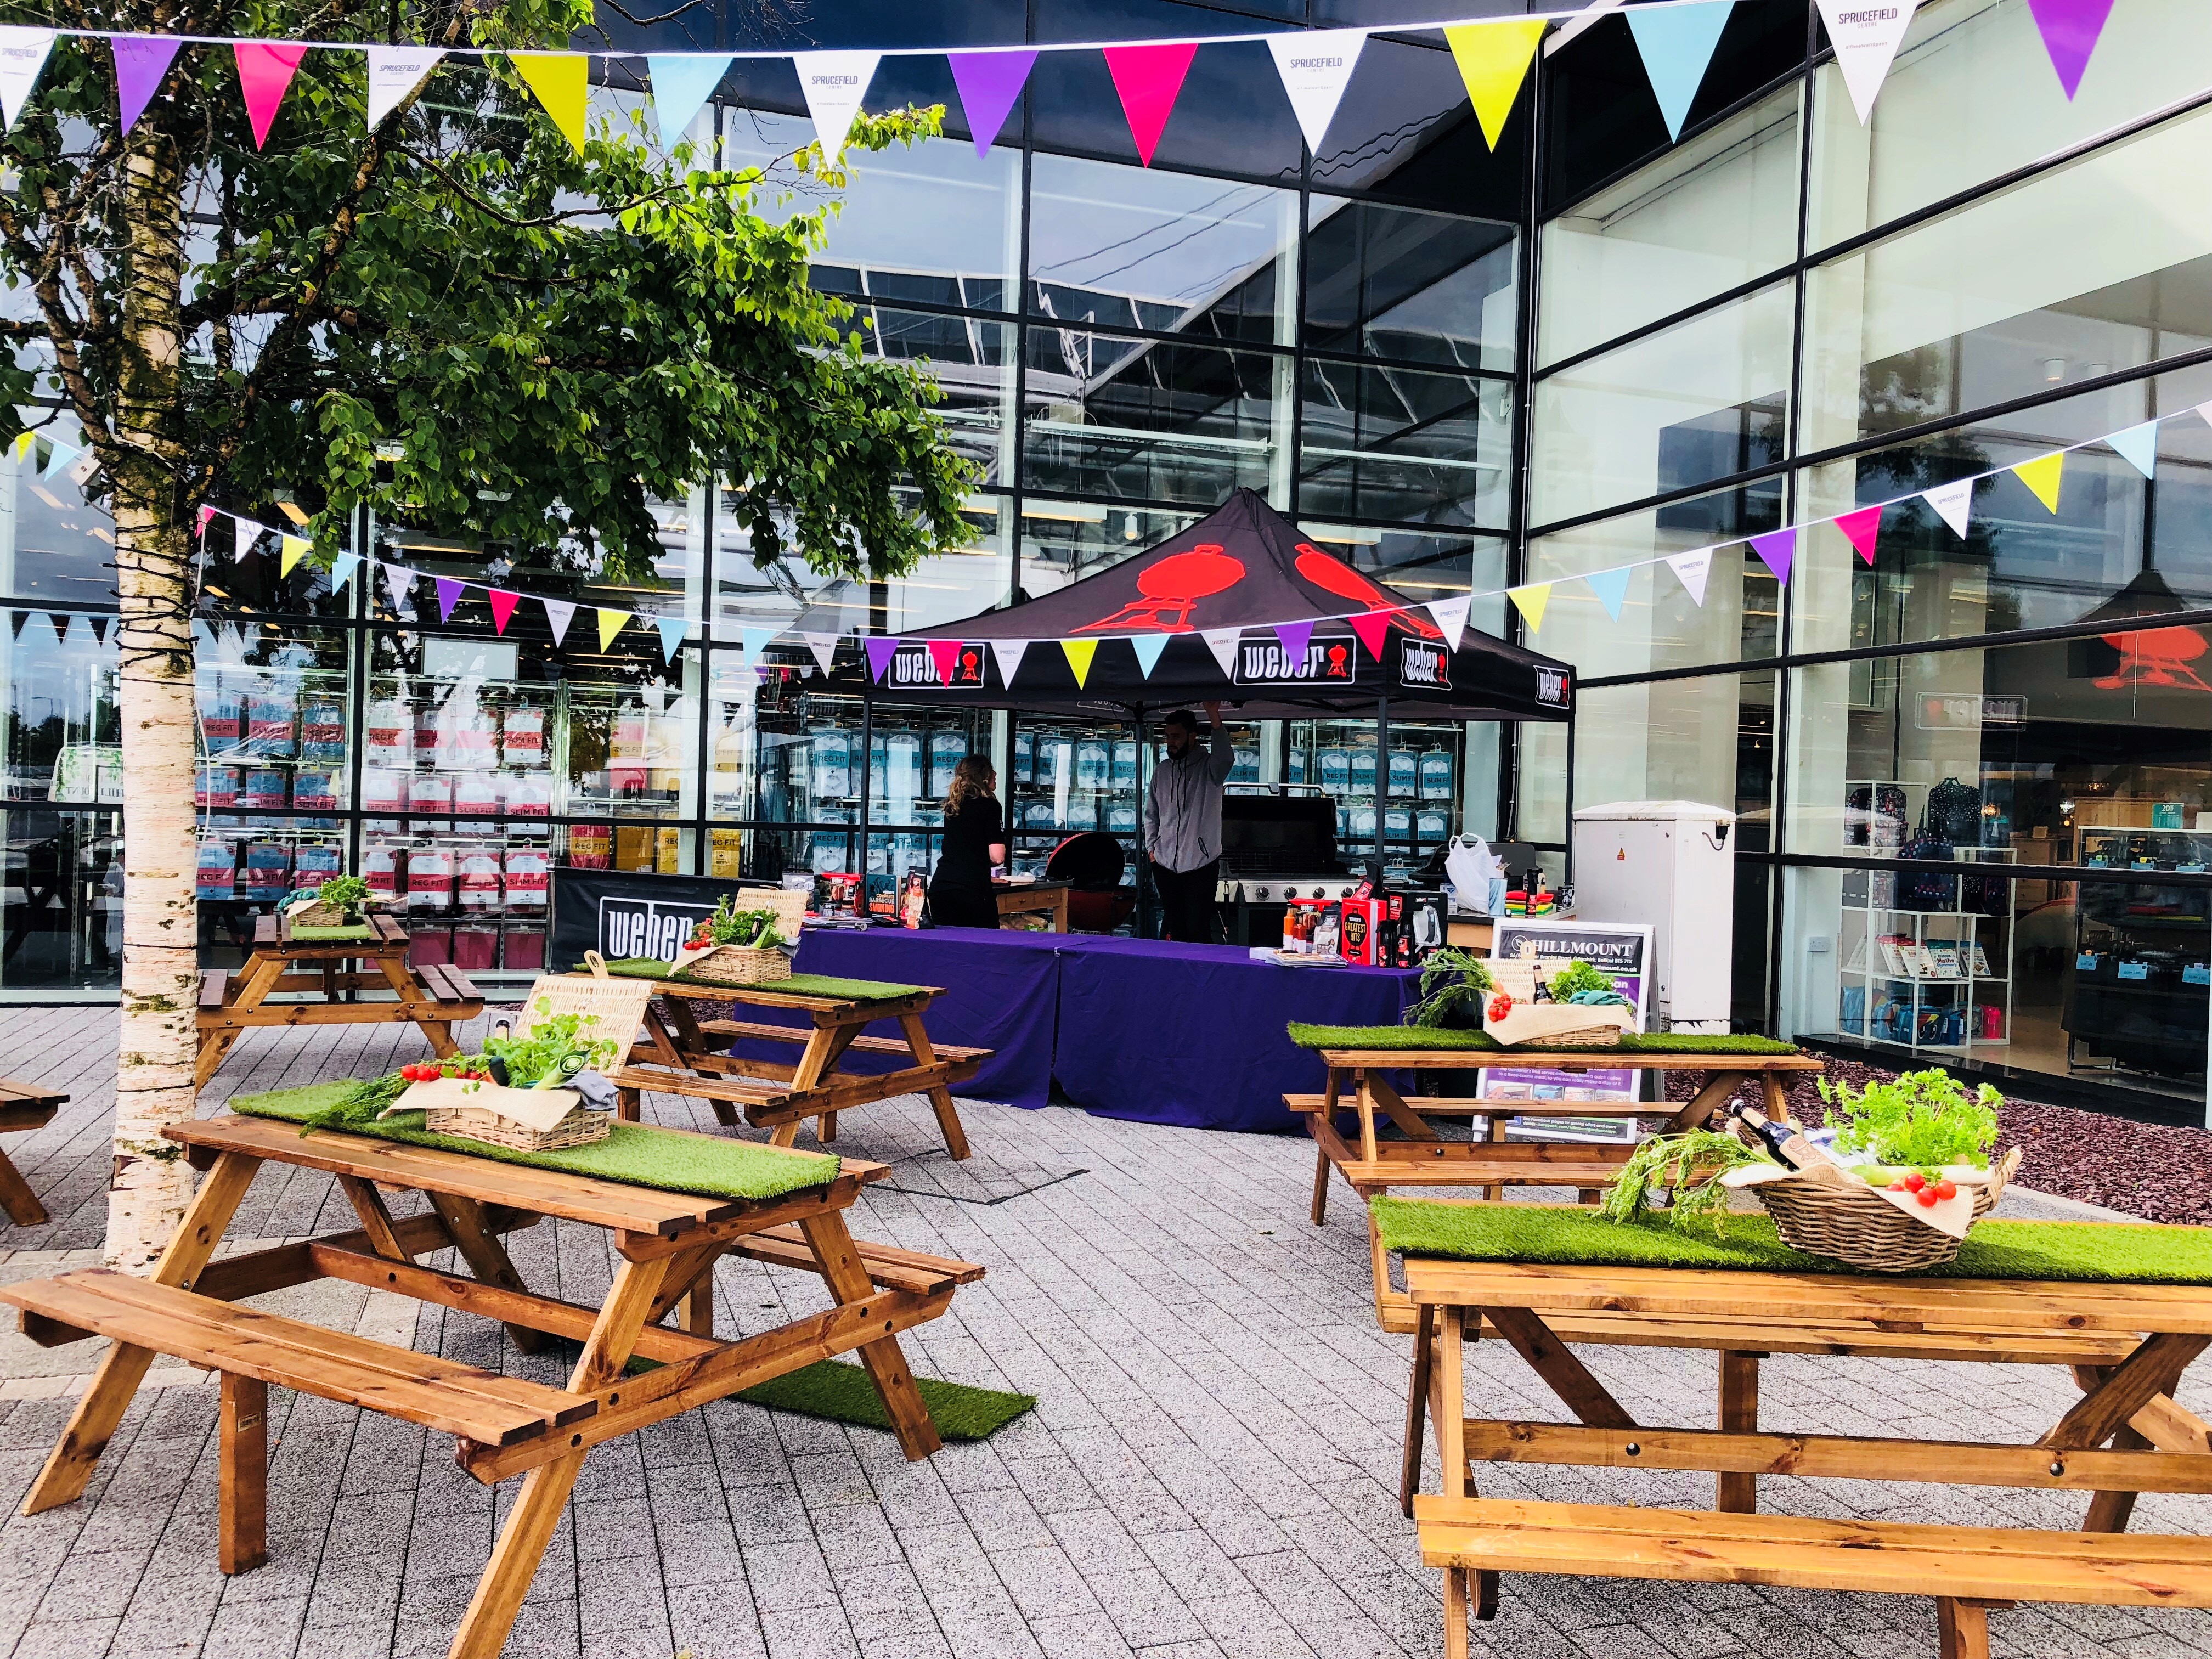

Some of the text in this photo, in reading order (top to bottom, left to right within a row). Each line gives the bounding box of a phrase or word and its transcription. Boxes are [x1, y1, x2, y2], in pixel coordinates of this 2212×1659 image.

[1838, 8, 1898, 25] SPRUCEFIELD
[1290, 57, 1342, 69] SPRUCEFIELD
[811, 75, 858, 84] SPRUCEFIELD
[1405, 646, 1438, 682] weber
[1538, 672, 1562, 702] weber
[868, 902, 895, 913] SMOKING
[607, 905, 694, 962] weber
[1345, 922, 1366, 933] GREATEST
[1350, 932, 1361, 942] HITS
[1531, 939, 1633, 957] HILLMOUNT
